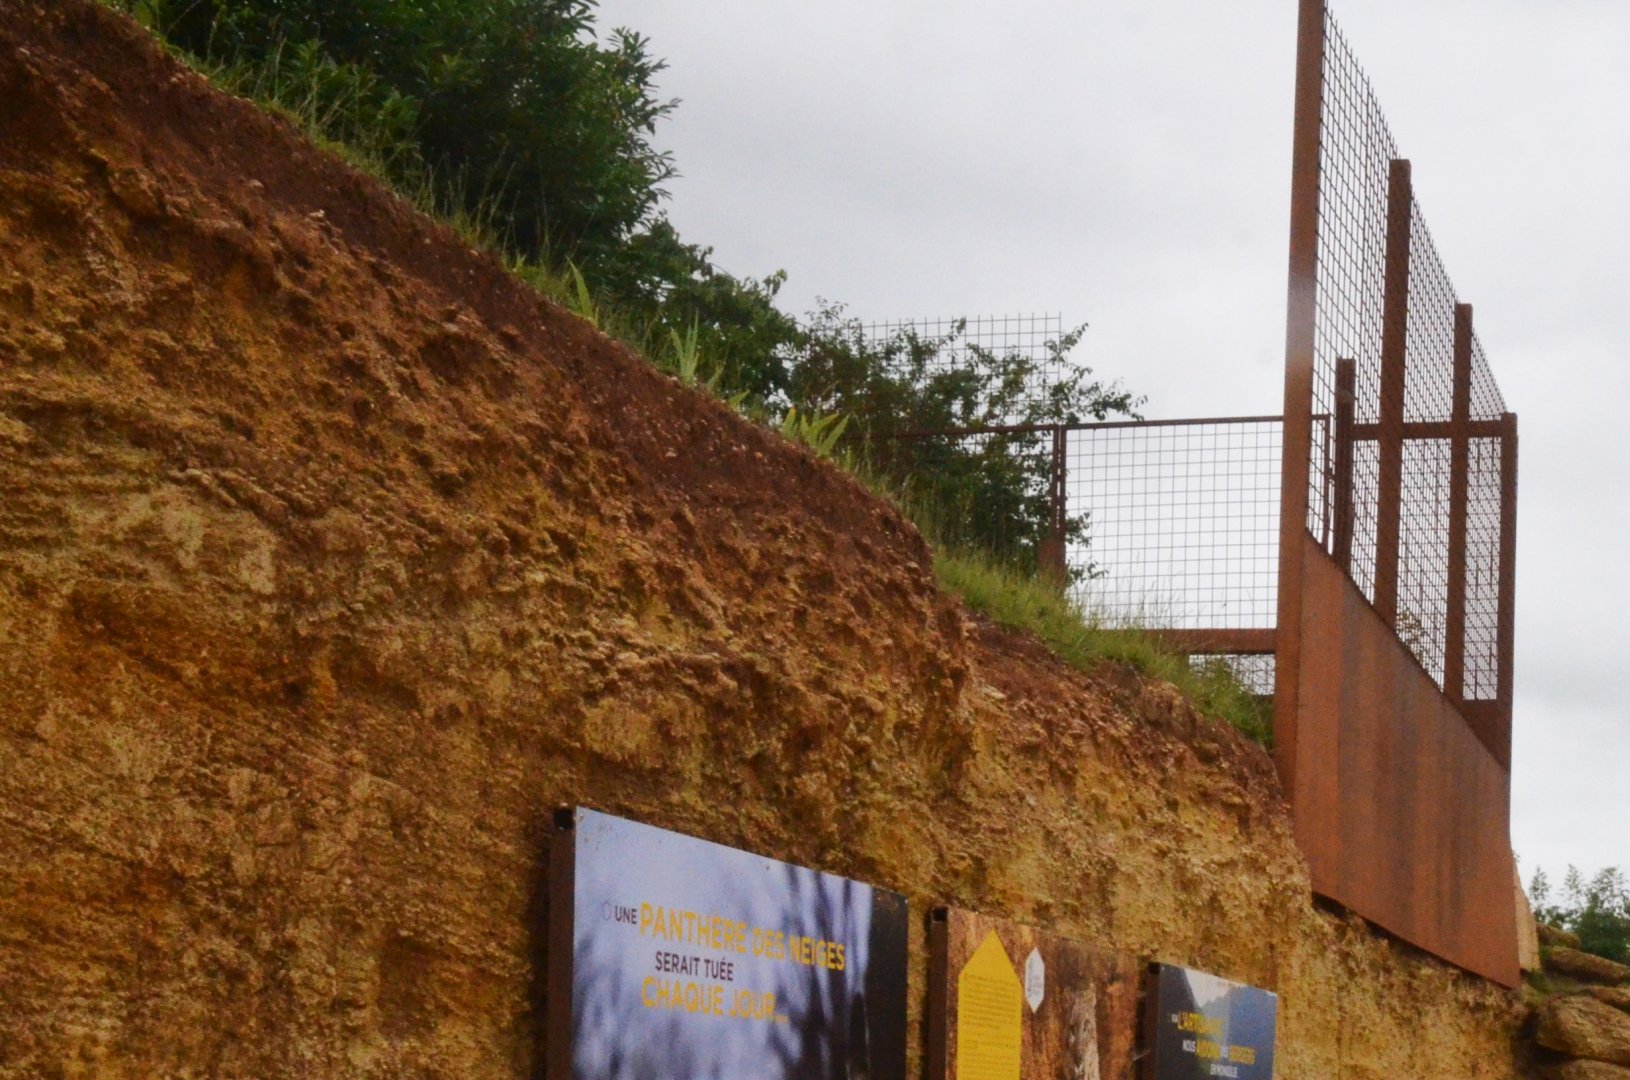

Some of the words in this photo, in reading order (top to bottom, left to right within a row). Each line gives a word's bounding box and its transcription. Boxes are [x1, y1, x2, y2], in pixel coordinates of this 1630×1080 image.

[614, 905, 637, 925] UNE
[639, 902, 748, 954] PANTHÈRE
[753, 928, 785, 960] DES
[789, 934, 846, 971] NEIGES
[655, 951, 701, 977] SERAIT
[704, 956, 735, 981] TUÉE
[641, 975, 724, 1017] CHAQUE
